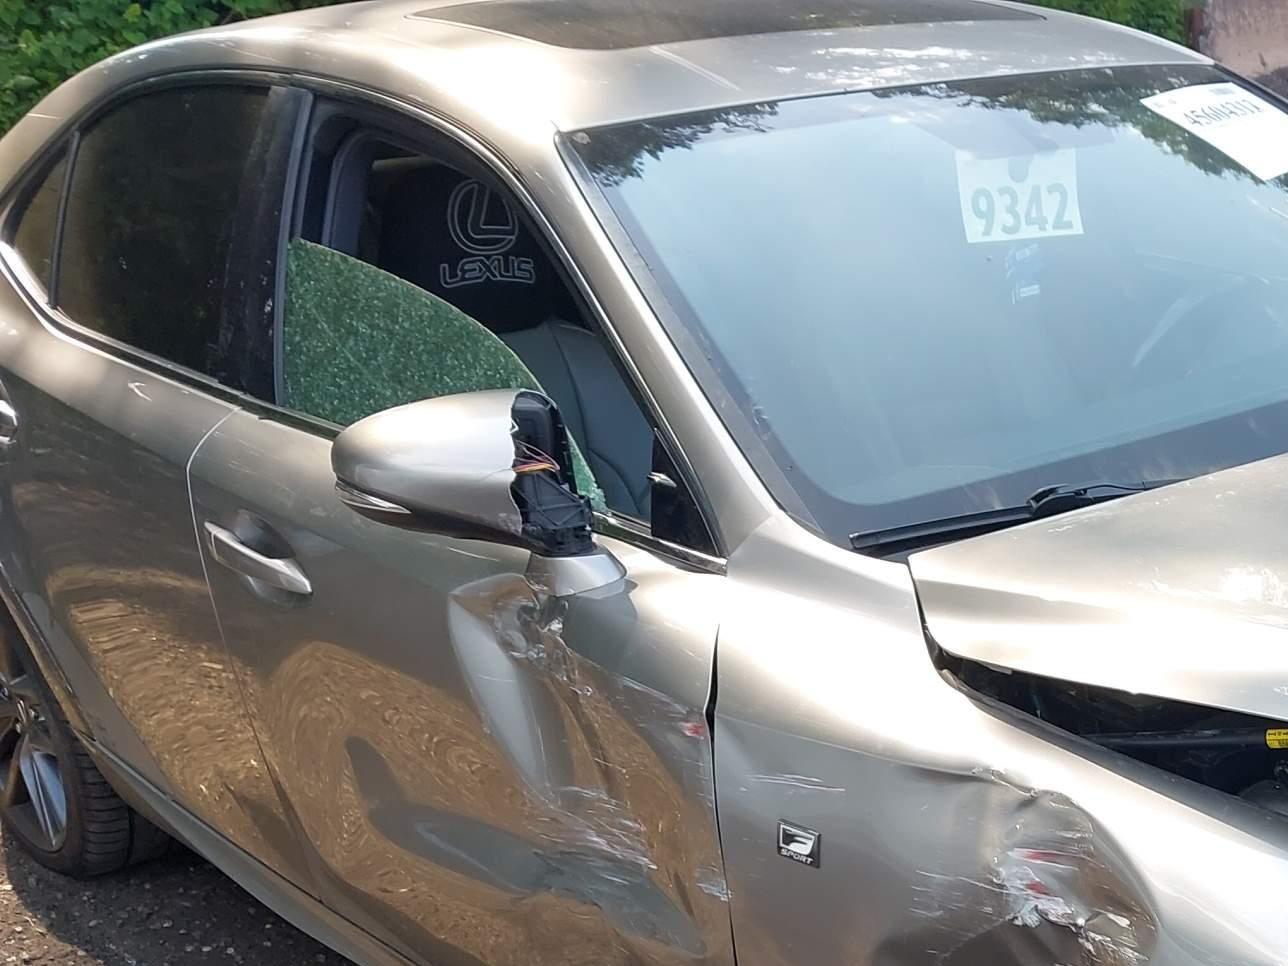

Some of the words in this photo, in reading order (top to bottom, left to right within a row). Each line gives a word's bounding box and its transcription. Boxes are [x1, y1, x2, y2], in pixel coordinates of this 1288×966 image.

[971, 183, 1074, 237] 9342
[440, 255, 536, 288] LEXUS
[780, 848, 814, 865] SPORT
